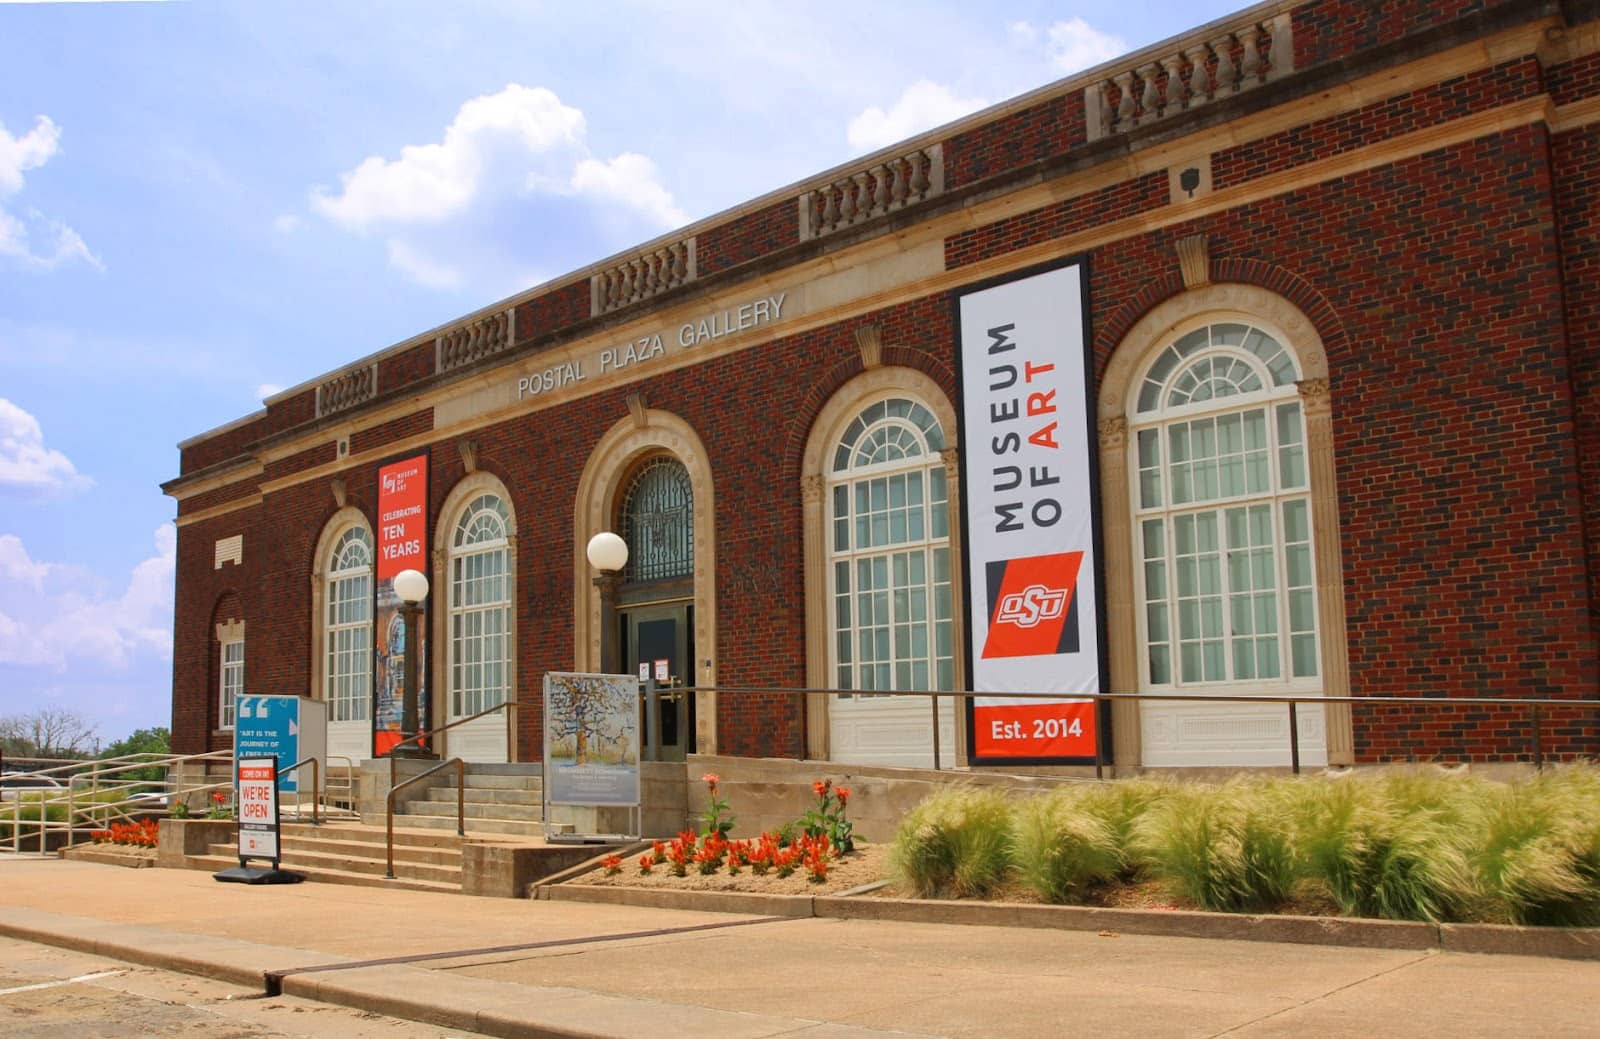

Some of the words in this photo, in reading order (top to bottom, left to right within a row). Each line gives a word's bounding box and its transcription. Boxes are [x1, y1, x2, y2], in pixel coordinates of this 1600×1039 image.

[518, 362, 586, 400] POSTAL
[600, 335, 665, 374] PLAZA
[680, 293, 786, 348] GALLERY
[1025, 360, 1059, 449] ART
[987, 322, 1024, 533] MUSEUM
[1030, 465, 1062, 528] OF
[383, 505, 421, 521] CELEBRATING
[383, 523, 404, 540] TEN
[383, 539, 420, 560] YEARS
[997, 584, 1068, 629] OSU
[991, 720, 1027, 739] Est.
[1032, 717, 1083, 739] 2014
[242, 786, 270, 801] WE'RE
[244, 803, 268, 818] OPEN
